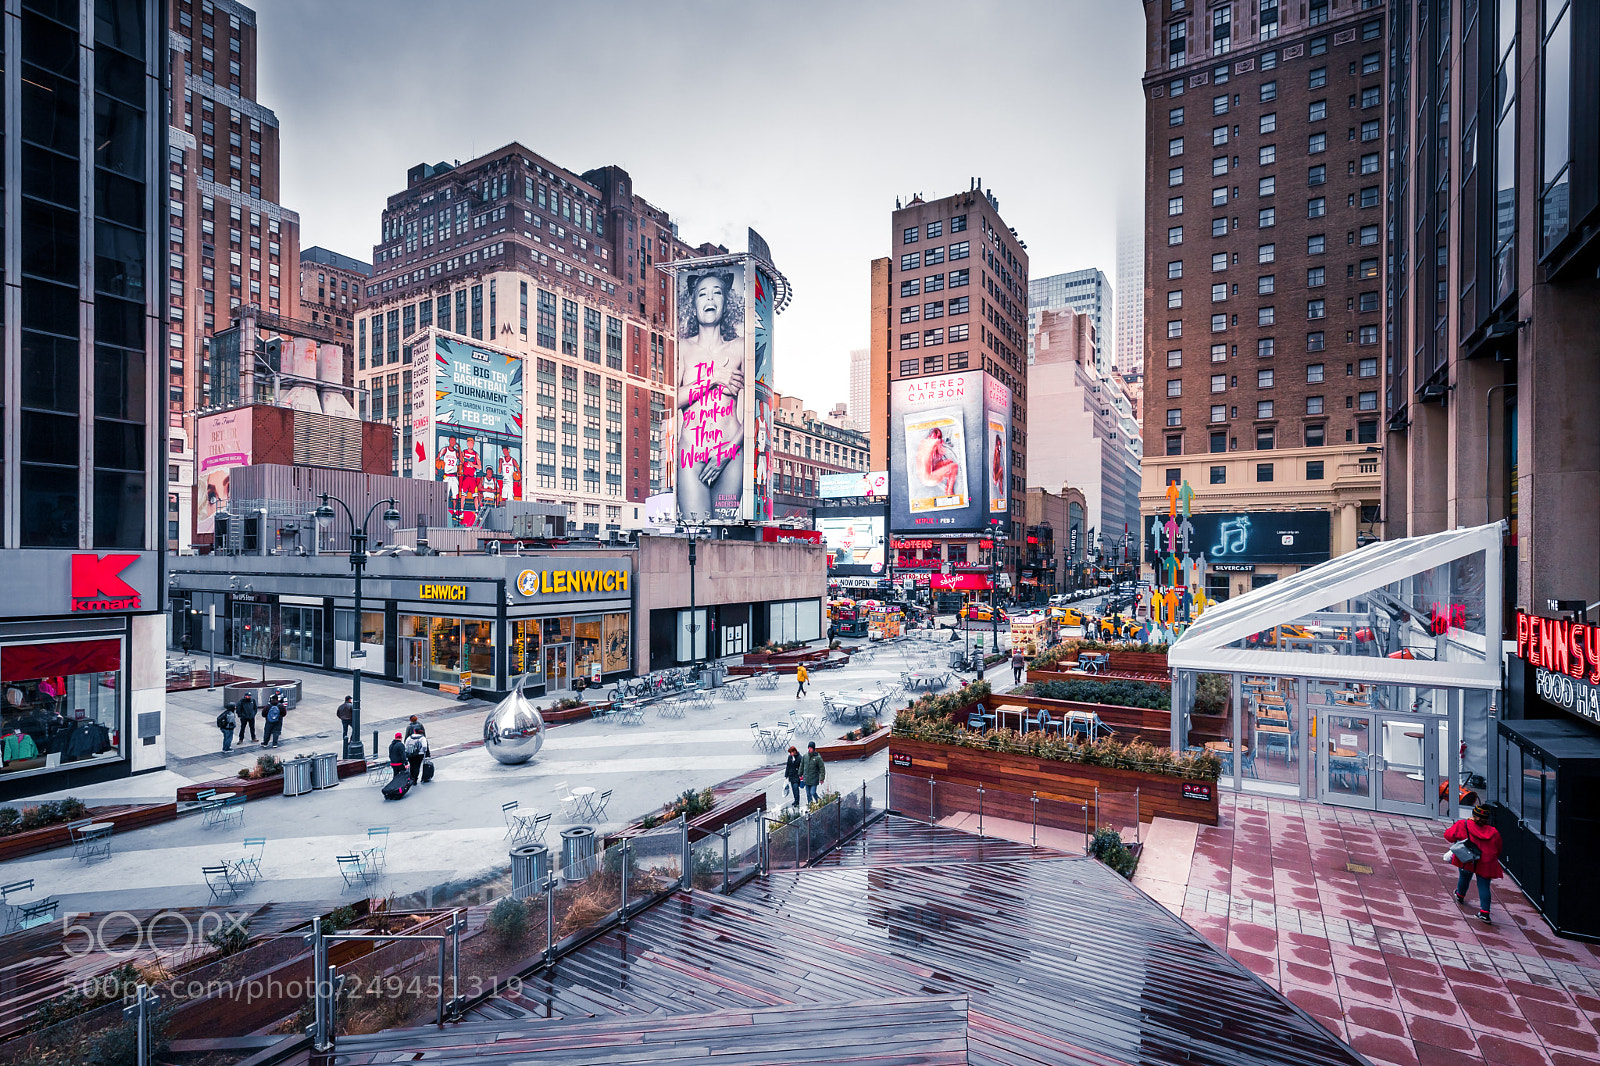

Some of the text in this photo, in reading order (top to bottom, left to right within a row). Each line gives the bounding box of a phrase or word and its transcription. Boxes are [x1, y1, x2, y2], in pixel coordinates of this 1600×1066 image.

[413, 341, 429, 358] FINALLY
[473, 351, 489, 362] BTN
[417, 354, 429, 366] GOOD
[413, 365, 428, 379] EXCUSE
[453, 361, 508, 384] THE BIG TEN
[693, 360, 714, 386] I'd
[413, 376, 429, 389] TO MISS
[453, 372, 508, 394] BASKETBALL
[908, 377, 965, 392] ALTERED
[413, 389, 424, 400] YOUR
[453, 384, 508, 404] TOURNAMENT
[688, 379, 726, 406] rather
[908, 387, 964, 402] CARBON
[413, 400, 425, 411] TRAIN
[463, 401, 482, 411] GARDEN
[485, 406, 507, 416] STARTING
[462, 410, 480, 423] FEB
[683, 399, 734, 428] go naked
[680, 444, 713, 469] Wear
[890, 539, 933, 549] HOOTERS
[897, 555, 944, 569] Subway
[541, 569, 628, 594] LENWICH
[840, 579, 854, 587] NOW
[854, 579, 870, 587] OPEN
[419, 584, 466, 601] LENWICH
[71, 595, 142, 612] kmart
[1547, 599, 1559, 611] THE
[1536, 667, 1574, 708] FOOD
